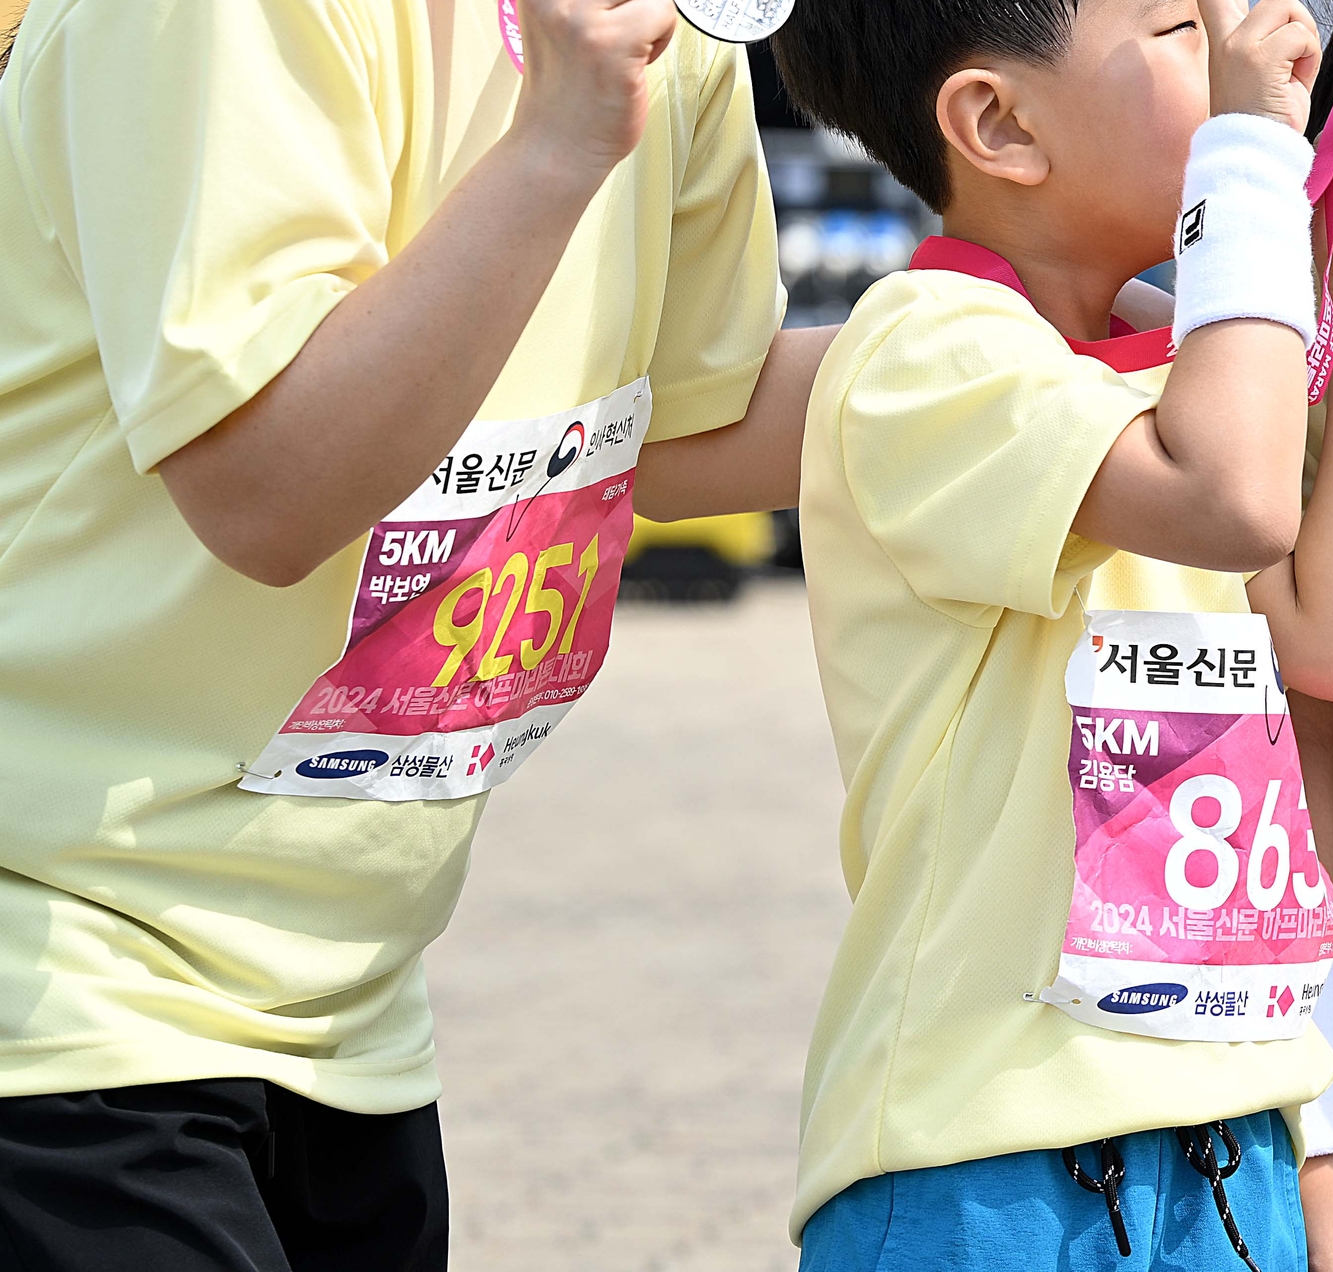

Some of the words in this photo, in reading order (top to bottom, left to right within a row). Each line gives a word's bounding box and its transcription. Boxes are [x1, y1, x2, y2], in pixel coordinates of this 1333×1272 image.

[377, 529, 457, 567] 5KM
[431, 532, 600, 688] 9251
[1099, 642, 1257, 689] 서울신문
[312, 685, 380, 715] 2024
[503, 722, 552, 753] Heungkuk
[1074, 715, 1160, 757] 5KM
[307, 755, 376, 774] SAMSUNG
[390, 754, 454, 780] 삼성물산
[1078, 759, 1137, 794] 김용담
[1089, 899, 1153, 936] 2024
[1160, 904, 1259, 942] 서울신문
[1109, 989, 1178, 1008] SAMSUNG
[1193, 990, 1250, 1018] 삼성물산
